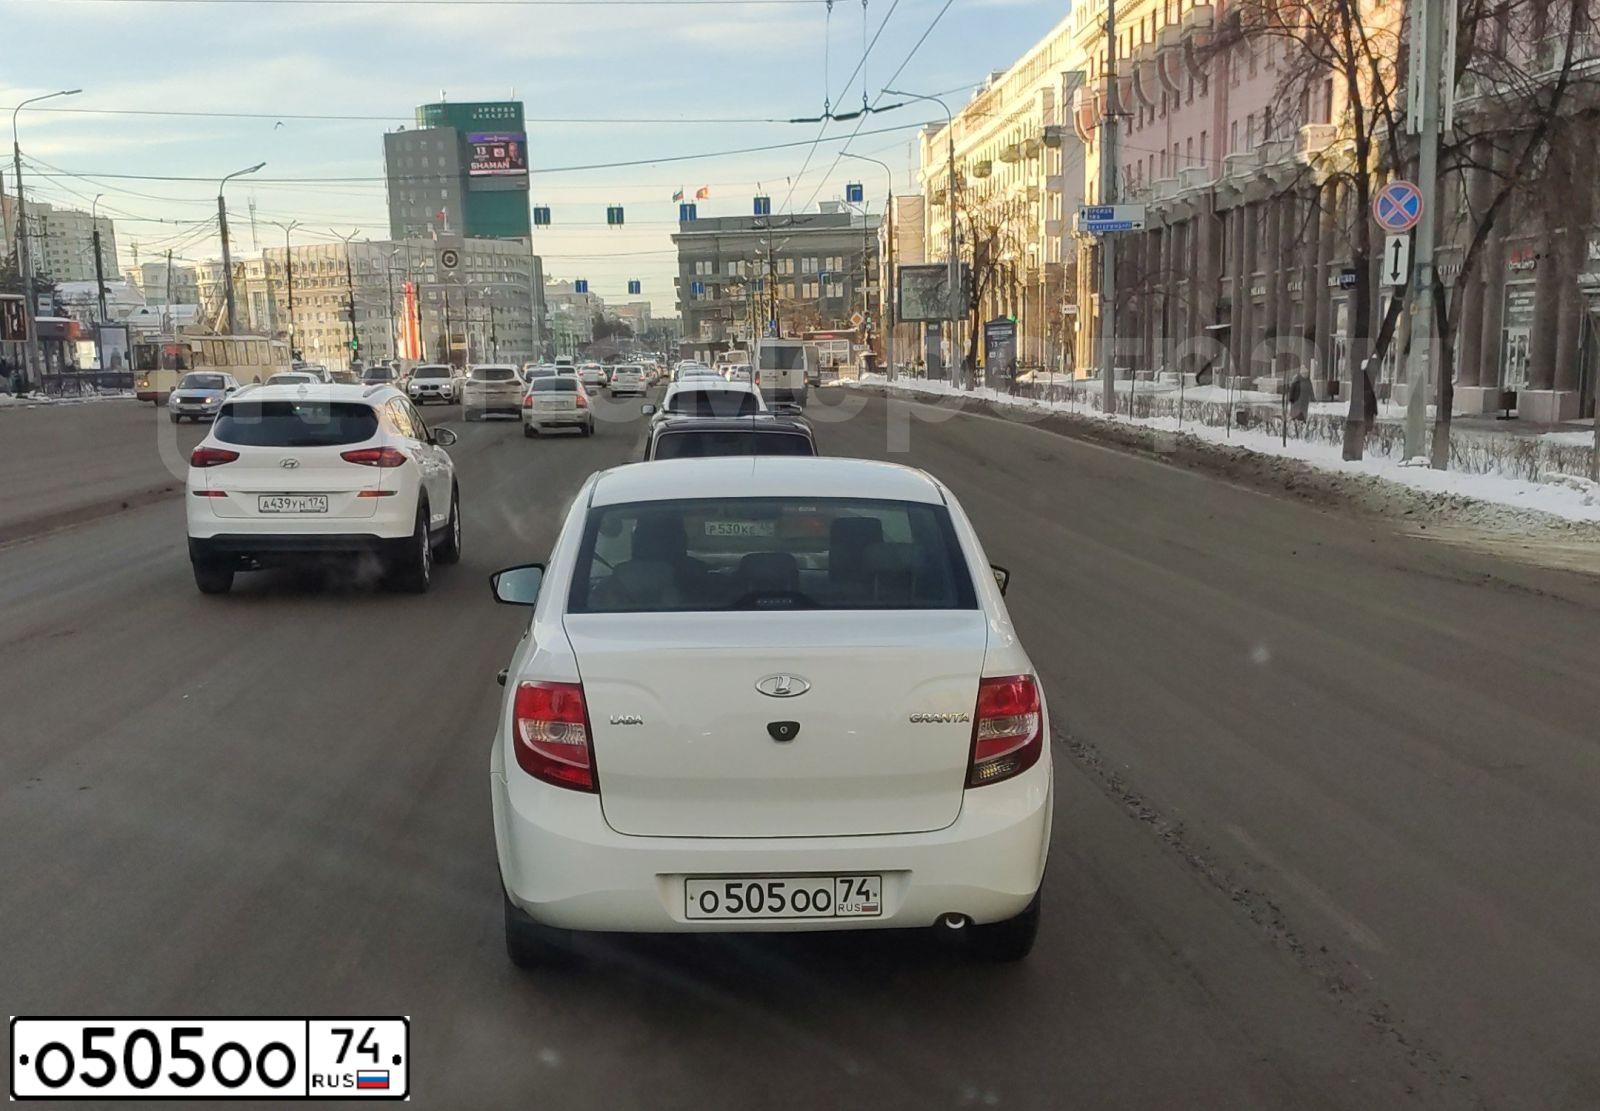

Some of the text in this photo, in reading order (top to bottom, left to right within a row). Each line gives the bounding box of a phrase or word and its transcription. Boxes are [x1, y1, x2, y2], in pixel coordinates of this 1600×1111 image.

[471, 162, 510, 170] SHAMAN
[610, 713, 644, 726] LADA
[909, 712, 970, 724] GRANTA
[839, 878, 871, 903] 74
[838, 903, 861, 912] RUS
